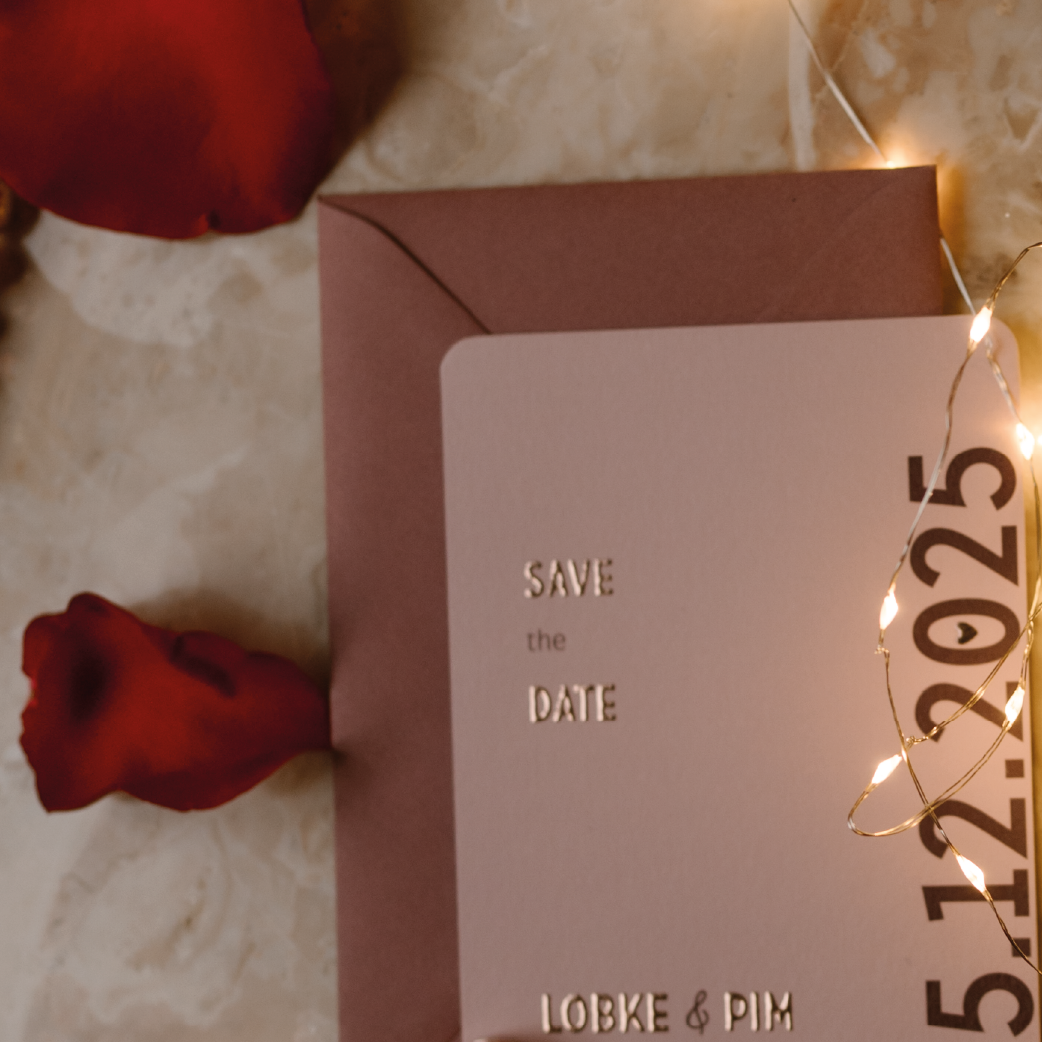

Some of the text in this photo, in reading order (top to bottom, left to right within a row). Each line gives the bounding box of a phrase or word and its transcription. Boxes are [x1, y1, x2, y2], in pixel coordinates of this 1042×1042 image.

[523, 558, 615, 598] SAVE
[526, 628, 566, 652] the
[528, 683, 617, 724] DATE
[540, 988, 794, 1036] LOBKE & PIM
